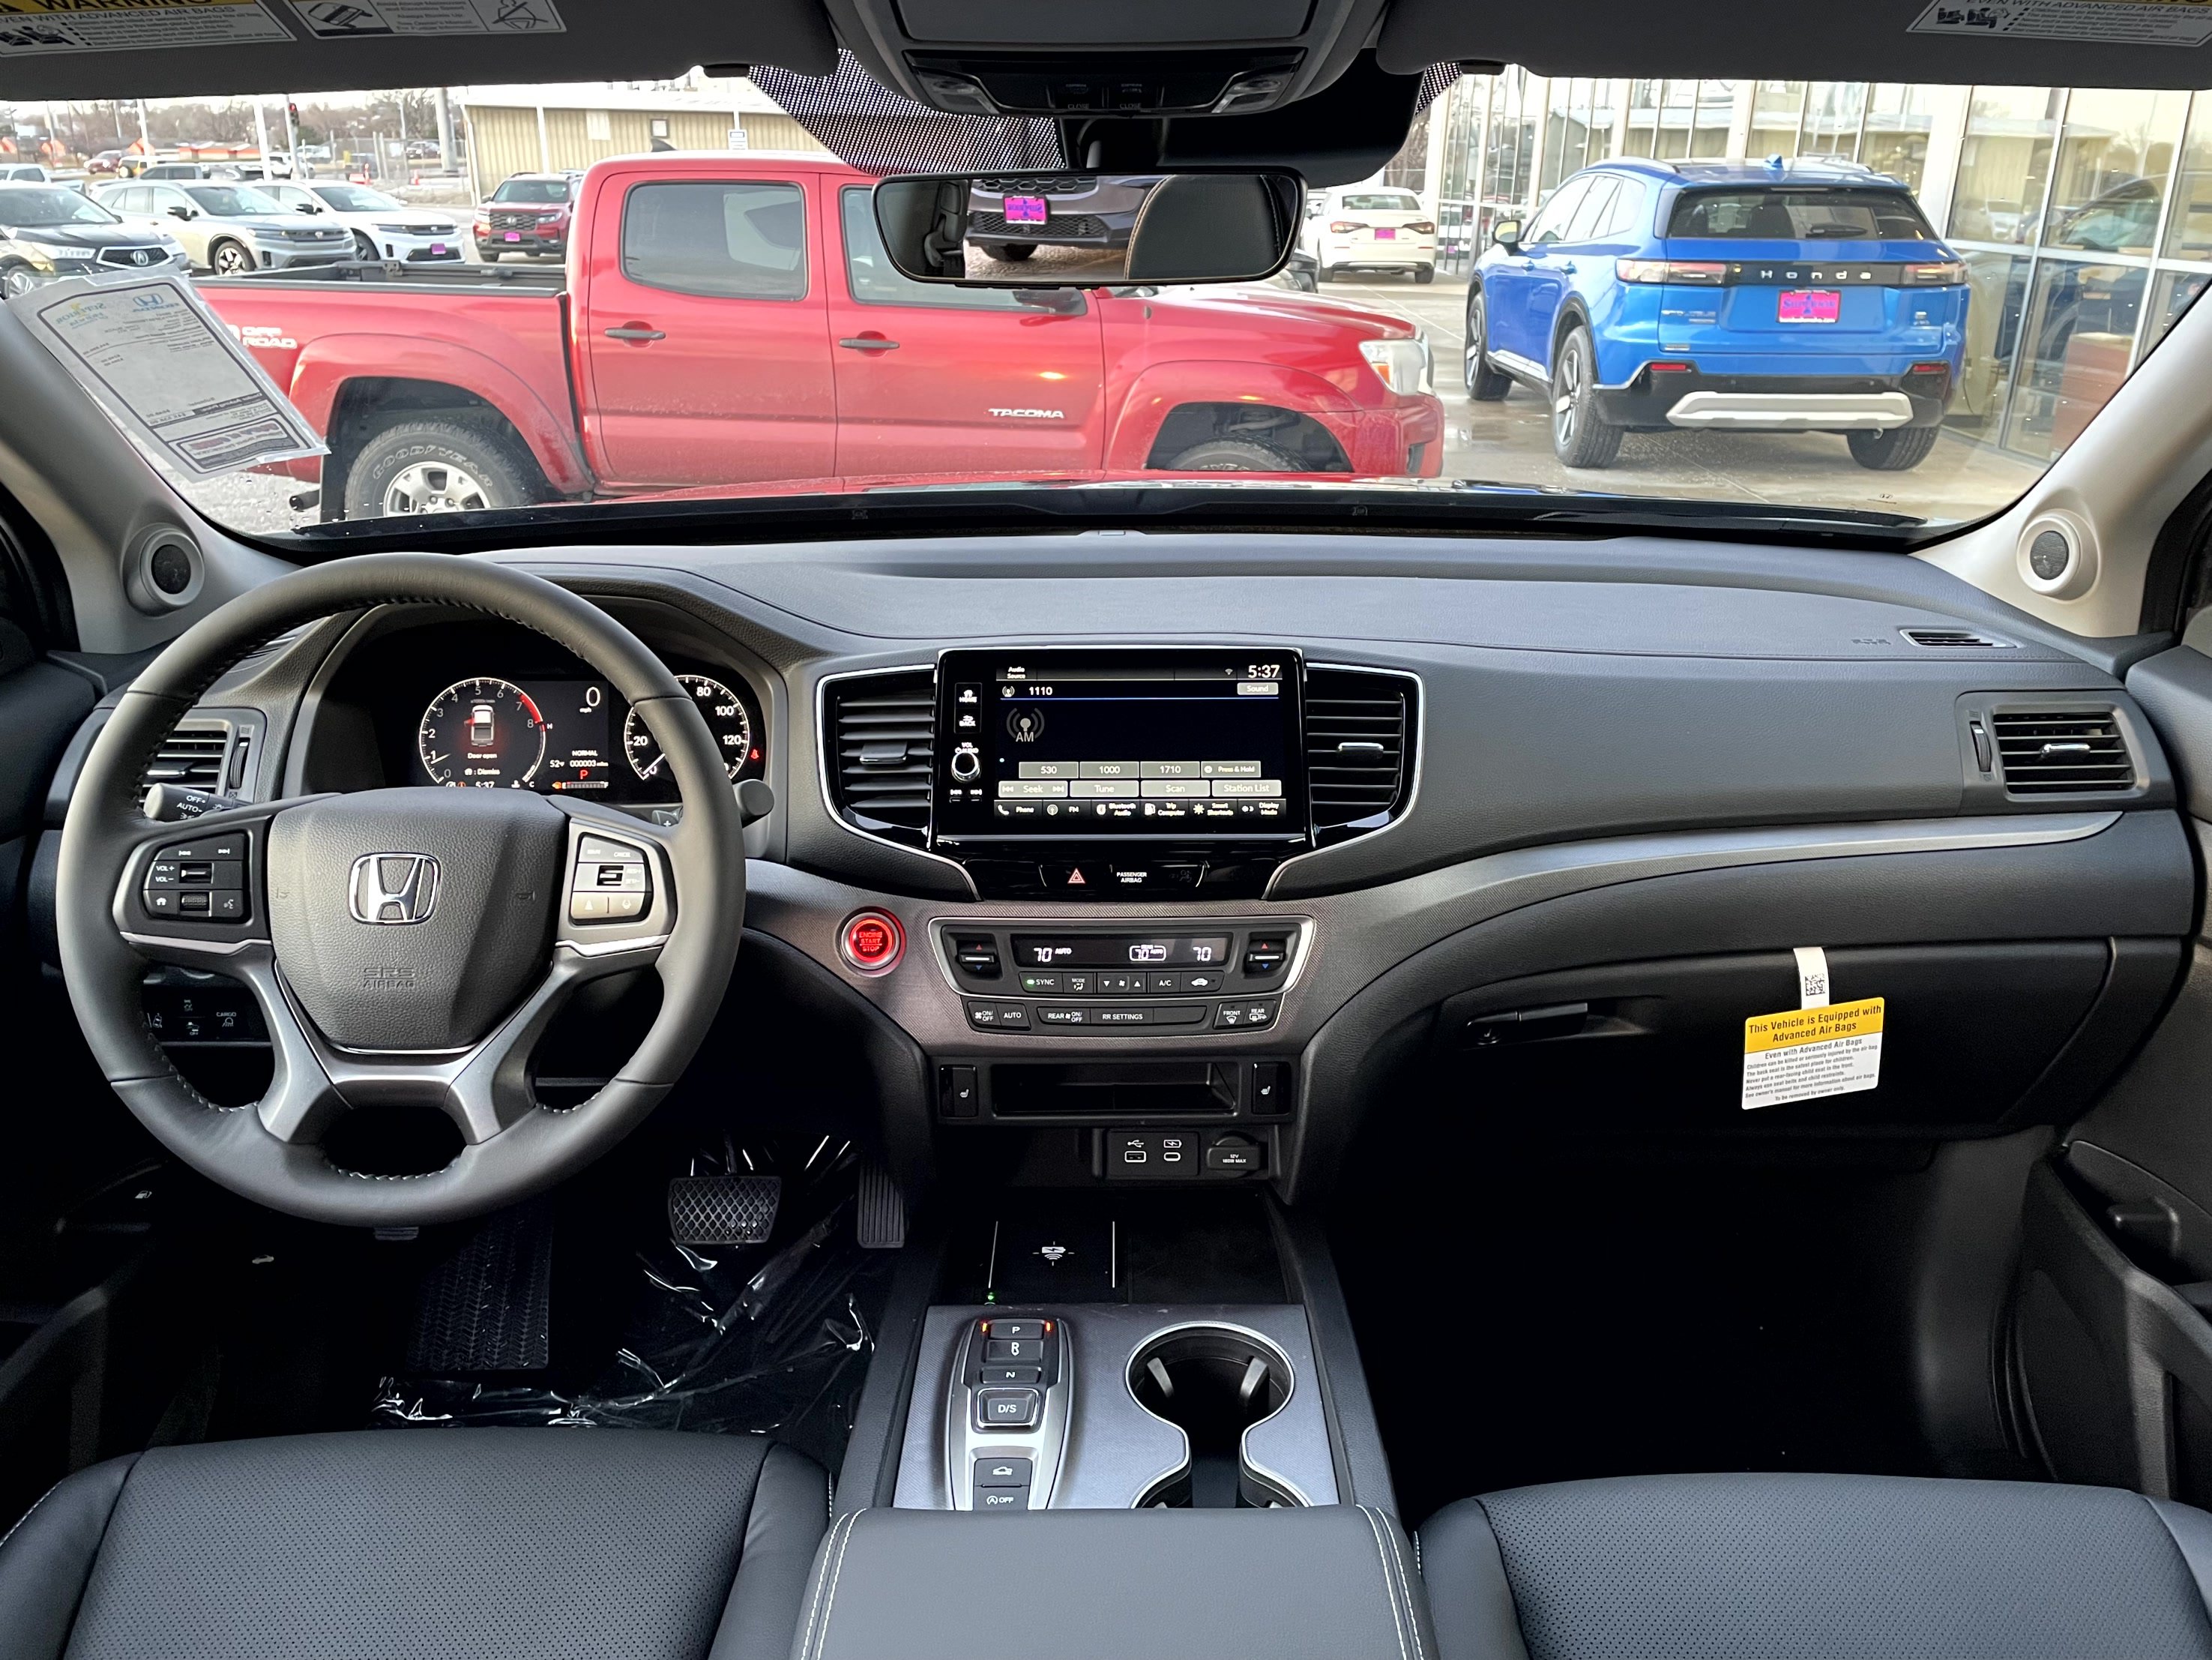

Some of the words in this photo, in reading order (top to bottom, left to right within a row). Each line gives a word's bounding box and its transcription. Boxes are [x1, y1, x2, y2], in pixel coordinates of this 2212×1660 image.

[2052, 1, 2136, 11] ADVANCED
[79, 10, 160, 19] ADVANCED
[1760, 270, 1871, 280] Honda
[242, 326, 282, 337] OFF
[243, 336, 298, 349] ROAD
[988, 409, 1064, 418] TACOMA
[1248, 664, 1280, 678] 5:37
[696, 687, 711, 697] 80
[1029, 686, 1053, 695] 1110
[586, 687, 600, 706] 0
[515, 702, 522, 711] 7
[715, 706, 734, 716] 100
[527, 719, 534, 728] 8
[428, 729, 436, 738] 2
[1015, 731, 1034, 742] AM
[633, 736, 648, 746] 20
[723, 735, 742, 745] 120
[430, 750, 436, 759] 1
[444, 769, 451, 778] 0
[580, 770, 588, 780] P
[1040, 766, 1057, 774] 530
[1099, 766, 1121, 774] 1000
[1023, 785, 1043, 793] Seek
[1094, 785, 1115, 793] Tune
[1166, 784, 1185, 793] Scan
[1224, 784, 1254, 793] Station
[1255, 784, 1269, 793] List
[177, 803, 199, 813] AUTO
[1034, 947, 1052, 962] 70
[1134, 949, 1149, 960] 70
[1193, 947, 1212, 961] 70
[1749, 1023, 1768, 1034] This
[1771, 1018, 1804, 1030] Vehicle
[1807, 1016, 1815, 1024] is
[1818, 1008, 1859, 1023] Equipped
[1863, 1005, 1881, 1016] with
[1772, 1028, 1816, 1042] Advanced
[1819, 1026, 1832, 1035] Air
[1835, 1022, 1857, 1032] Bags
[1799, 1043, 1832, 1054] Advanced
[1805, 1052, 1826, 1061] seriously
[1011, 1342, 1020, 1350] R
[998, 1404, 1017, 1413] D/S
